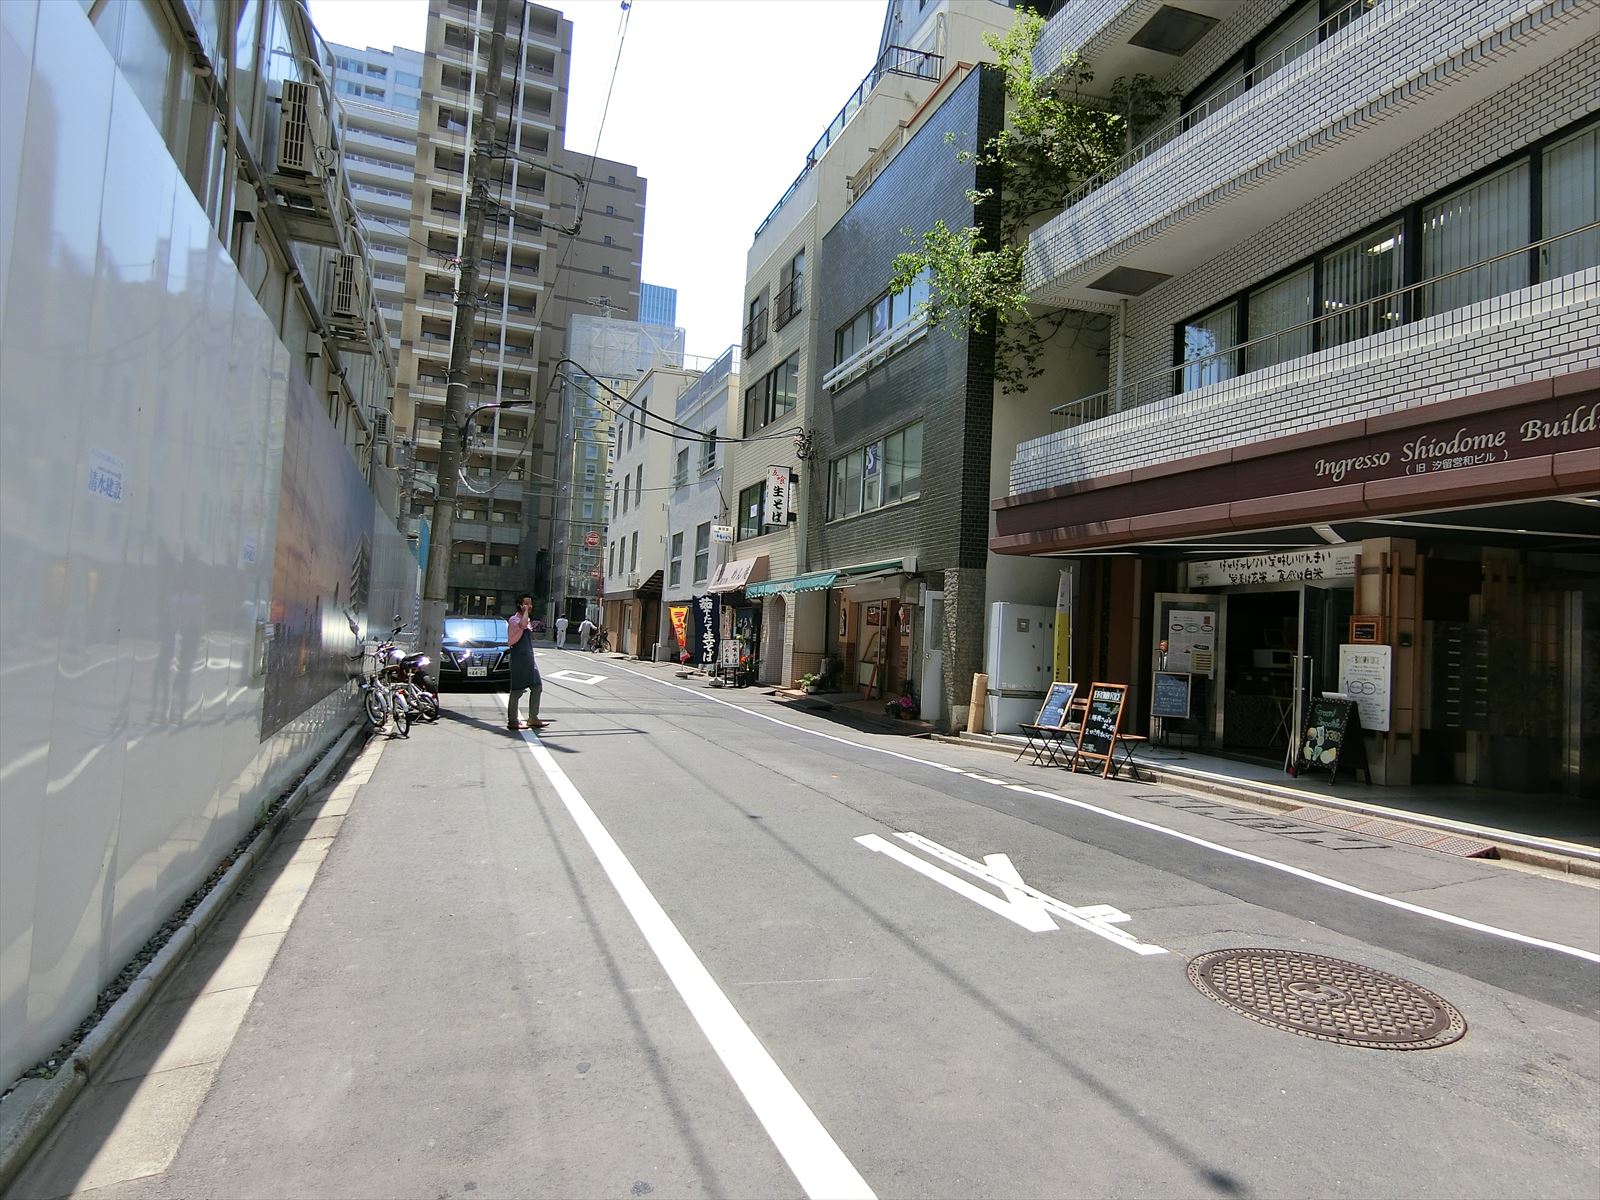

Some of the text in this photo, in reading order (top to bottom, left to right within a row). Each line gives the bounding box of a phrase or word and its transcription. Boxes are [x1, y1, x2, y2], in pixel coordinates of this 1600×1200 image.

[1314, 402, 1600, 482] Ingresso Shiodome Build
[772, 485, 784, 523] 生そば
